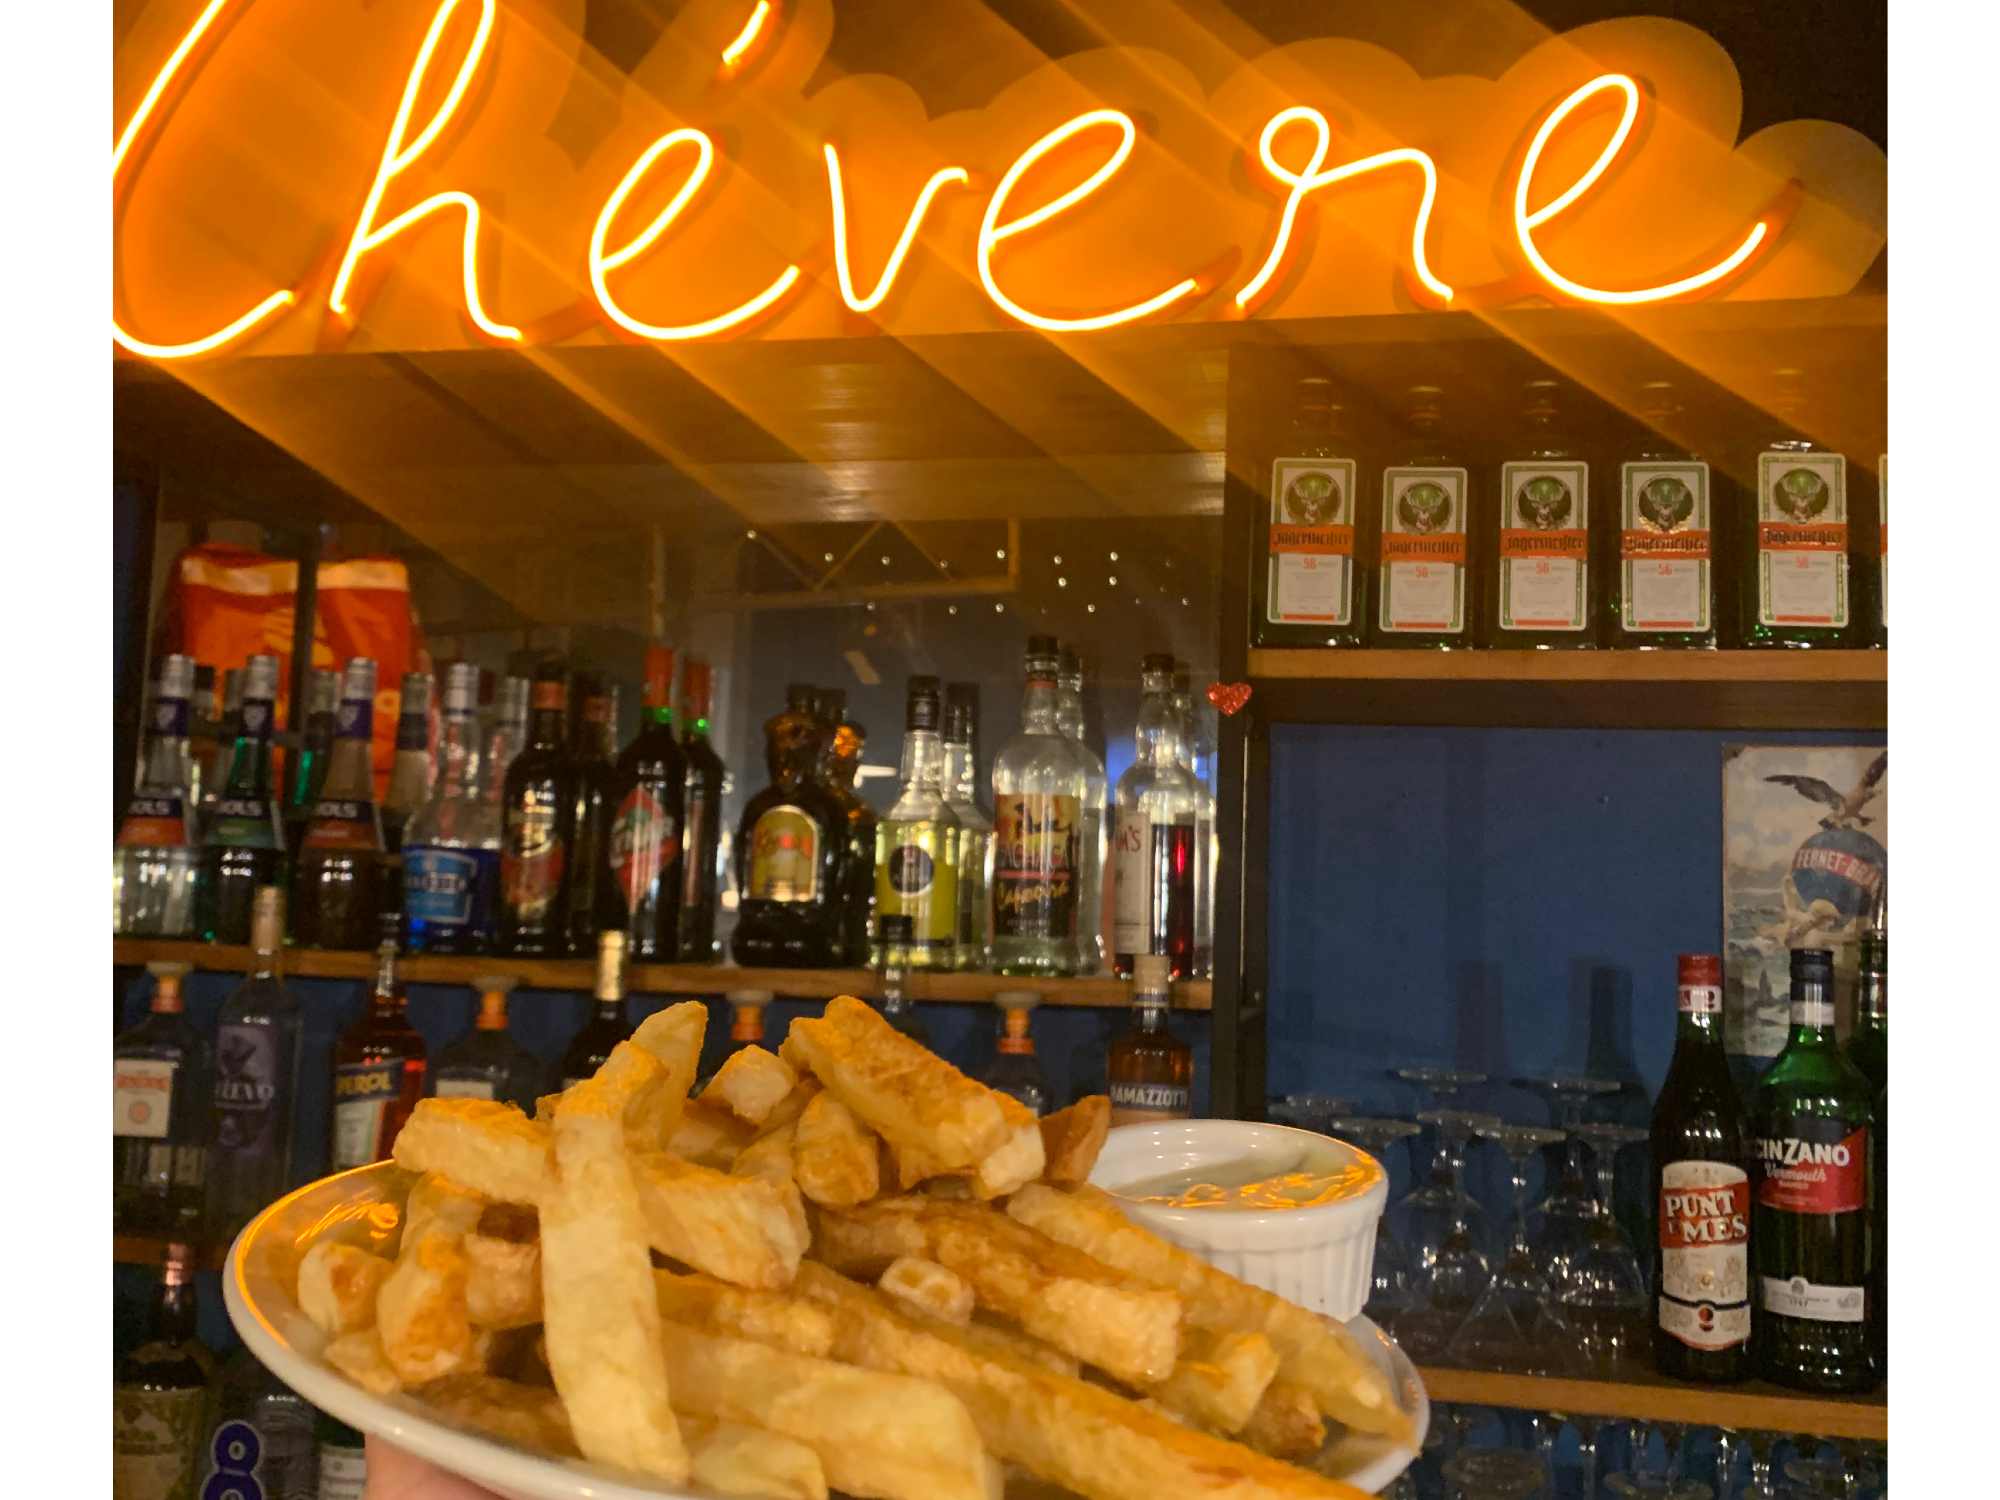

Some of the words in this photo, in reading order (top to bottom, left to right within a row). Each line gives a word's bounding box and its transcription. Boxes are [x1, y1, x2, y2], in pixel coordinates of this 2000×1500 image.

[113, 0, 1770, 358] Chévere
[1303, 558, 1316, 570] 56
[1415, 566, 1428, 578] 56
[1536, 562, 1549, 574] 56
[1658, 563, 1672, 575] 56
[1795, 556, 1809, 569] 56
[1000, 841, 1070, 872] ACHAÇA
[336, 1071, 392, 1096] PEROL
[1764, 1161, 1827, 1182] Vermouth
[1664, 1189, 1735, 1218] PUNT
[1682, 1213, 1748, 1243] MES
